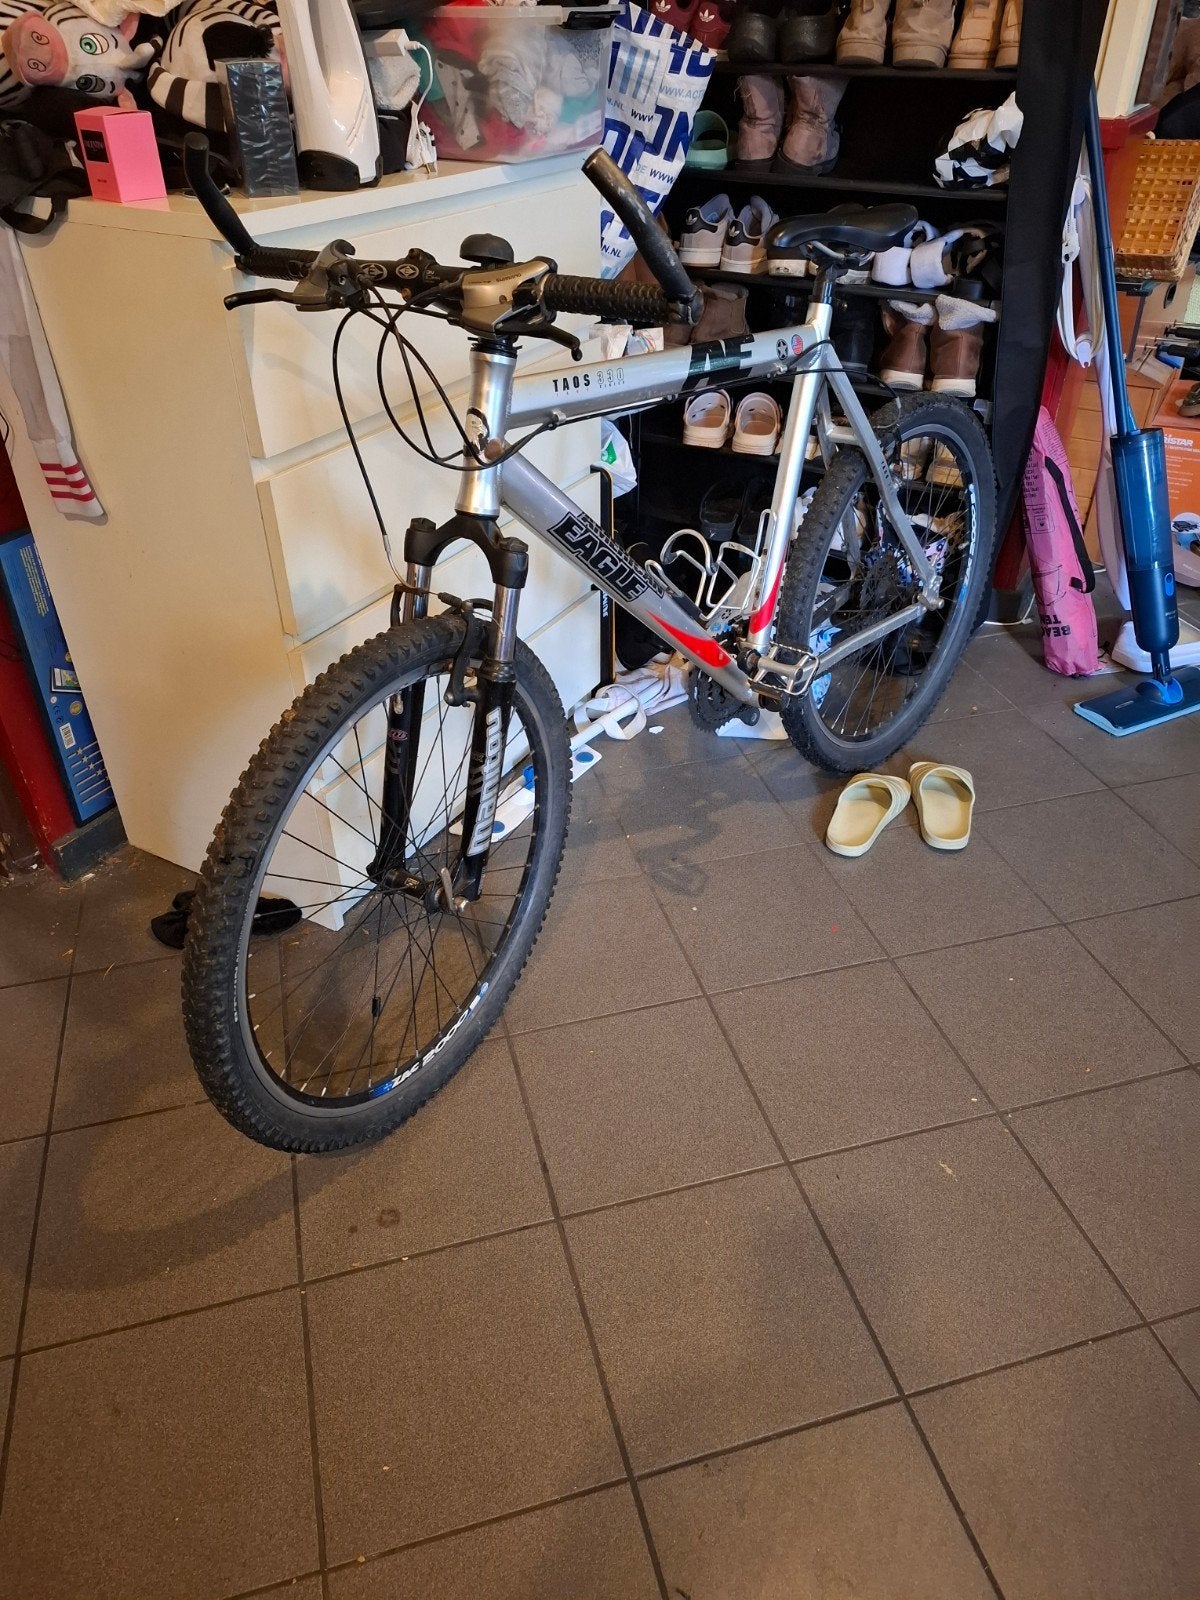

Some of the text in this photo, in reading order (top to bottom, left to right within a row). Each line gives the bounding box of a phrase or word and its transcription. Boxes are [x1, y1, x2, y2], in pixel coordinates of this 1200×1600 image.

[552, 373, 591, 393] TAOS
[597, 367, 625, 385] 330
[547, 511, 649, 602] EAGLE
